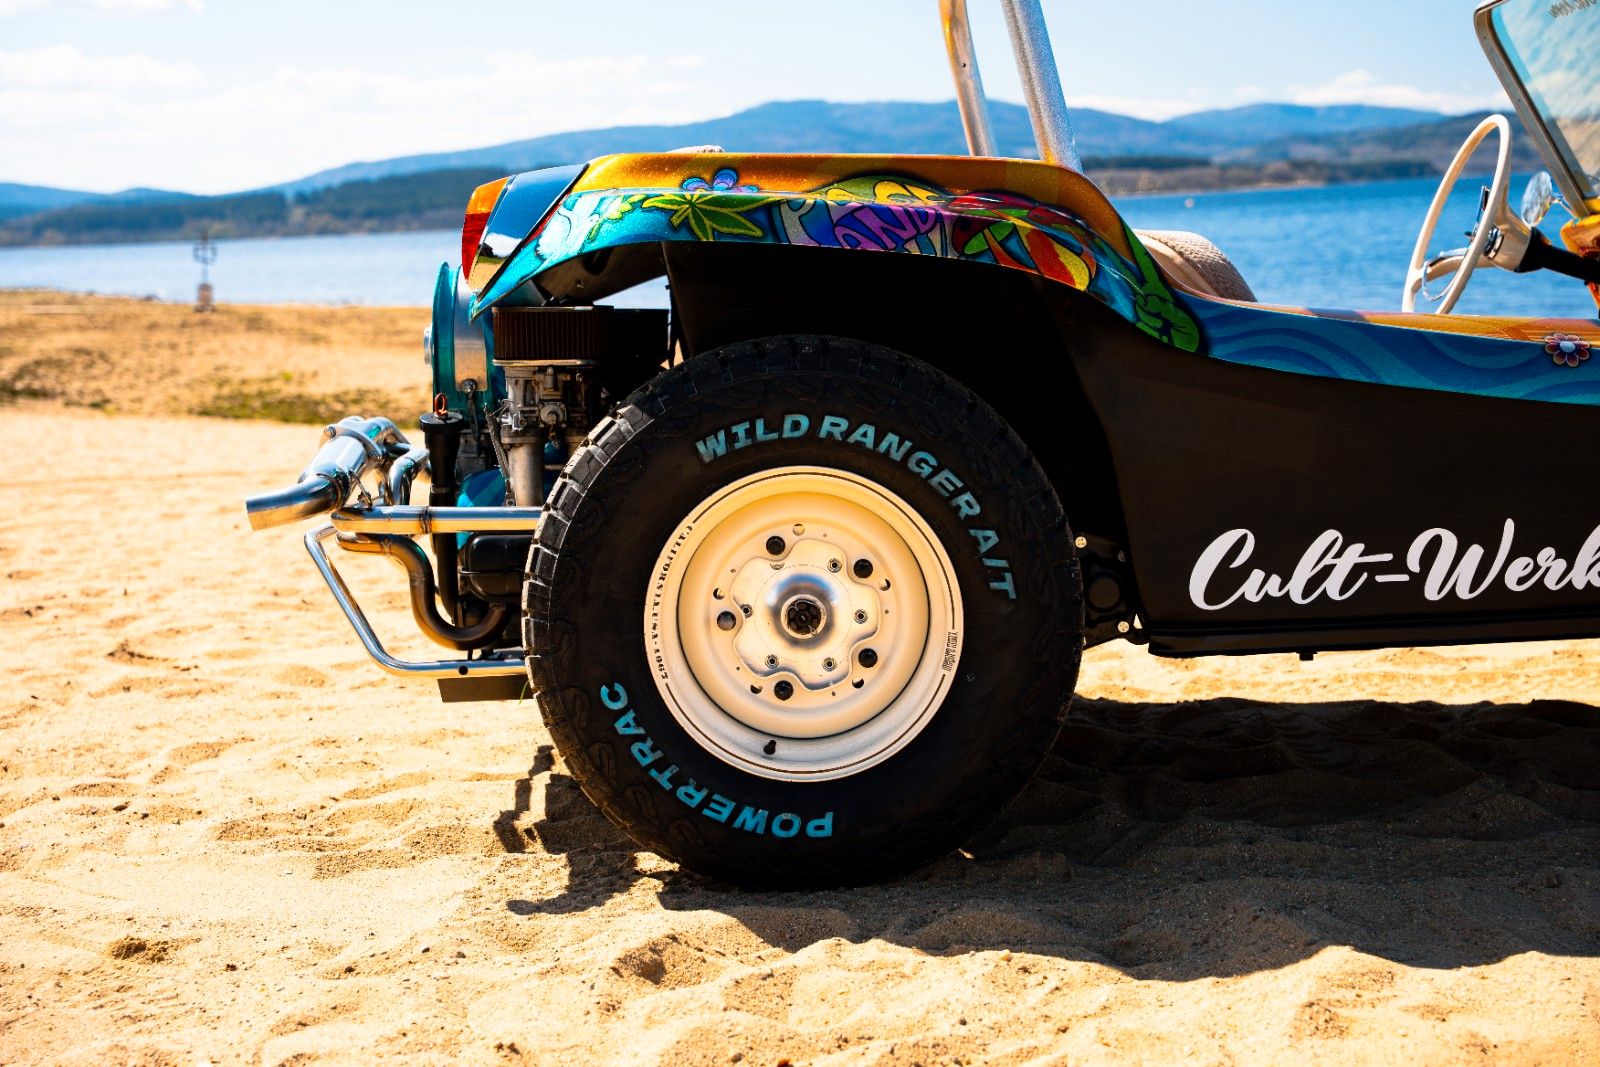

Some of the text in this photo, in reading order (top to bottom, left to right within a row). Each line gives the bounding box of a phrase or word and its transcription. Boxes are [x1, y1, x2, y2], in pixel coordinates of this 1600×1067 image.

[695, 413, 1017, 600] WILD RANGER A/T
[600, 682, 834, 838] POWERTRAC
